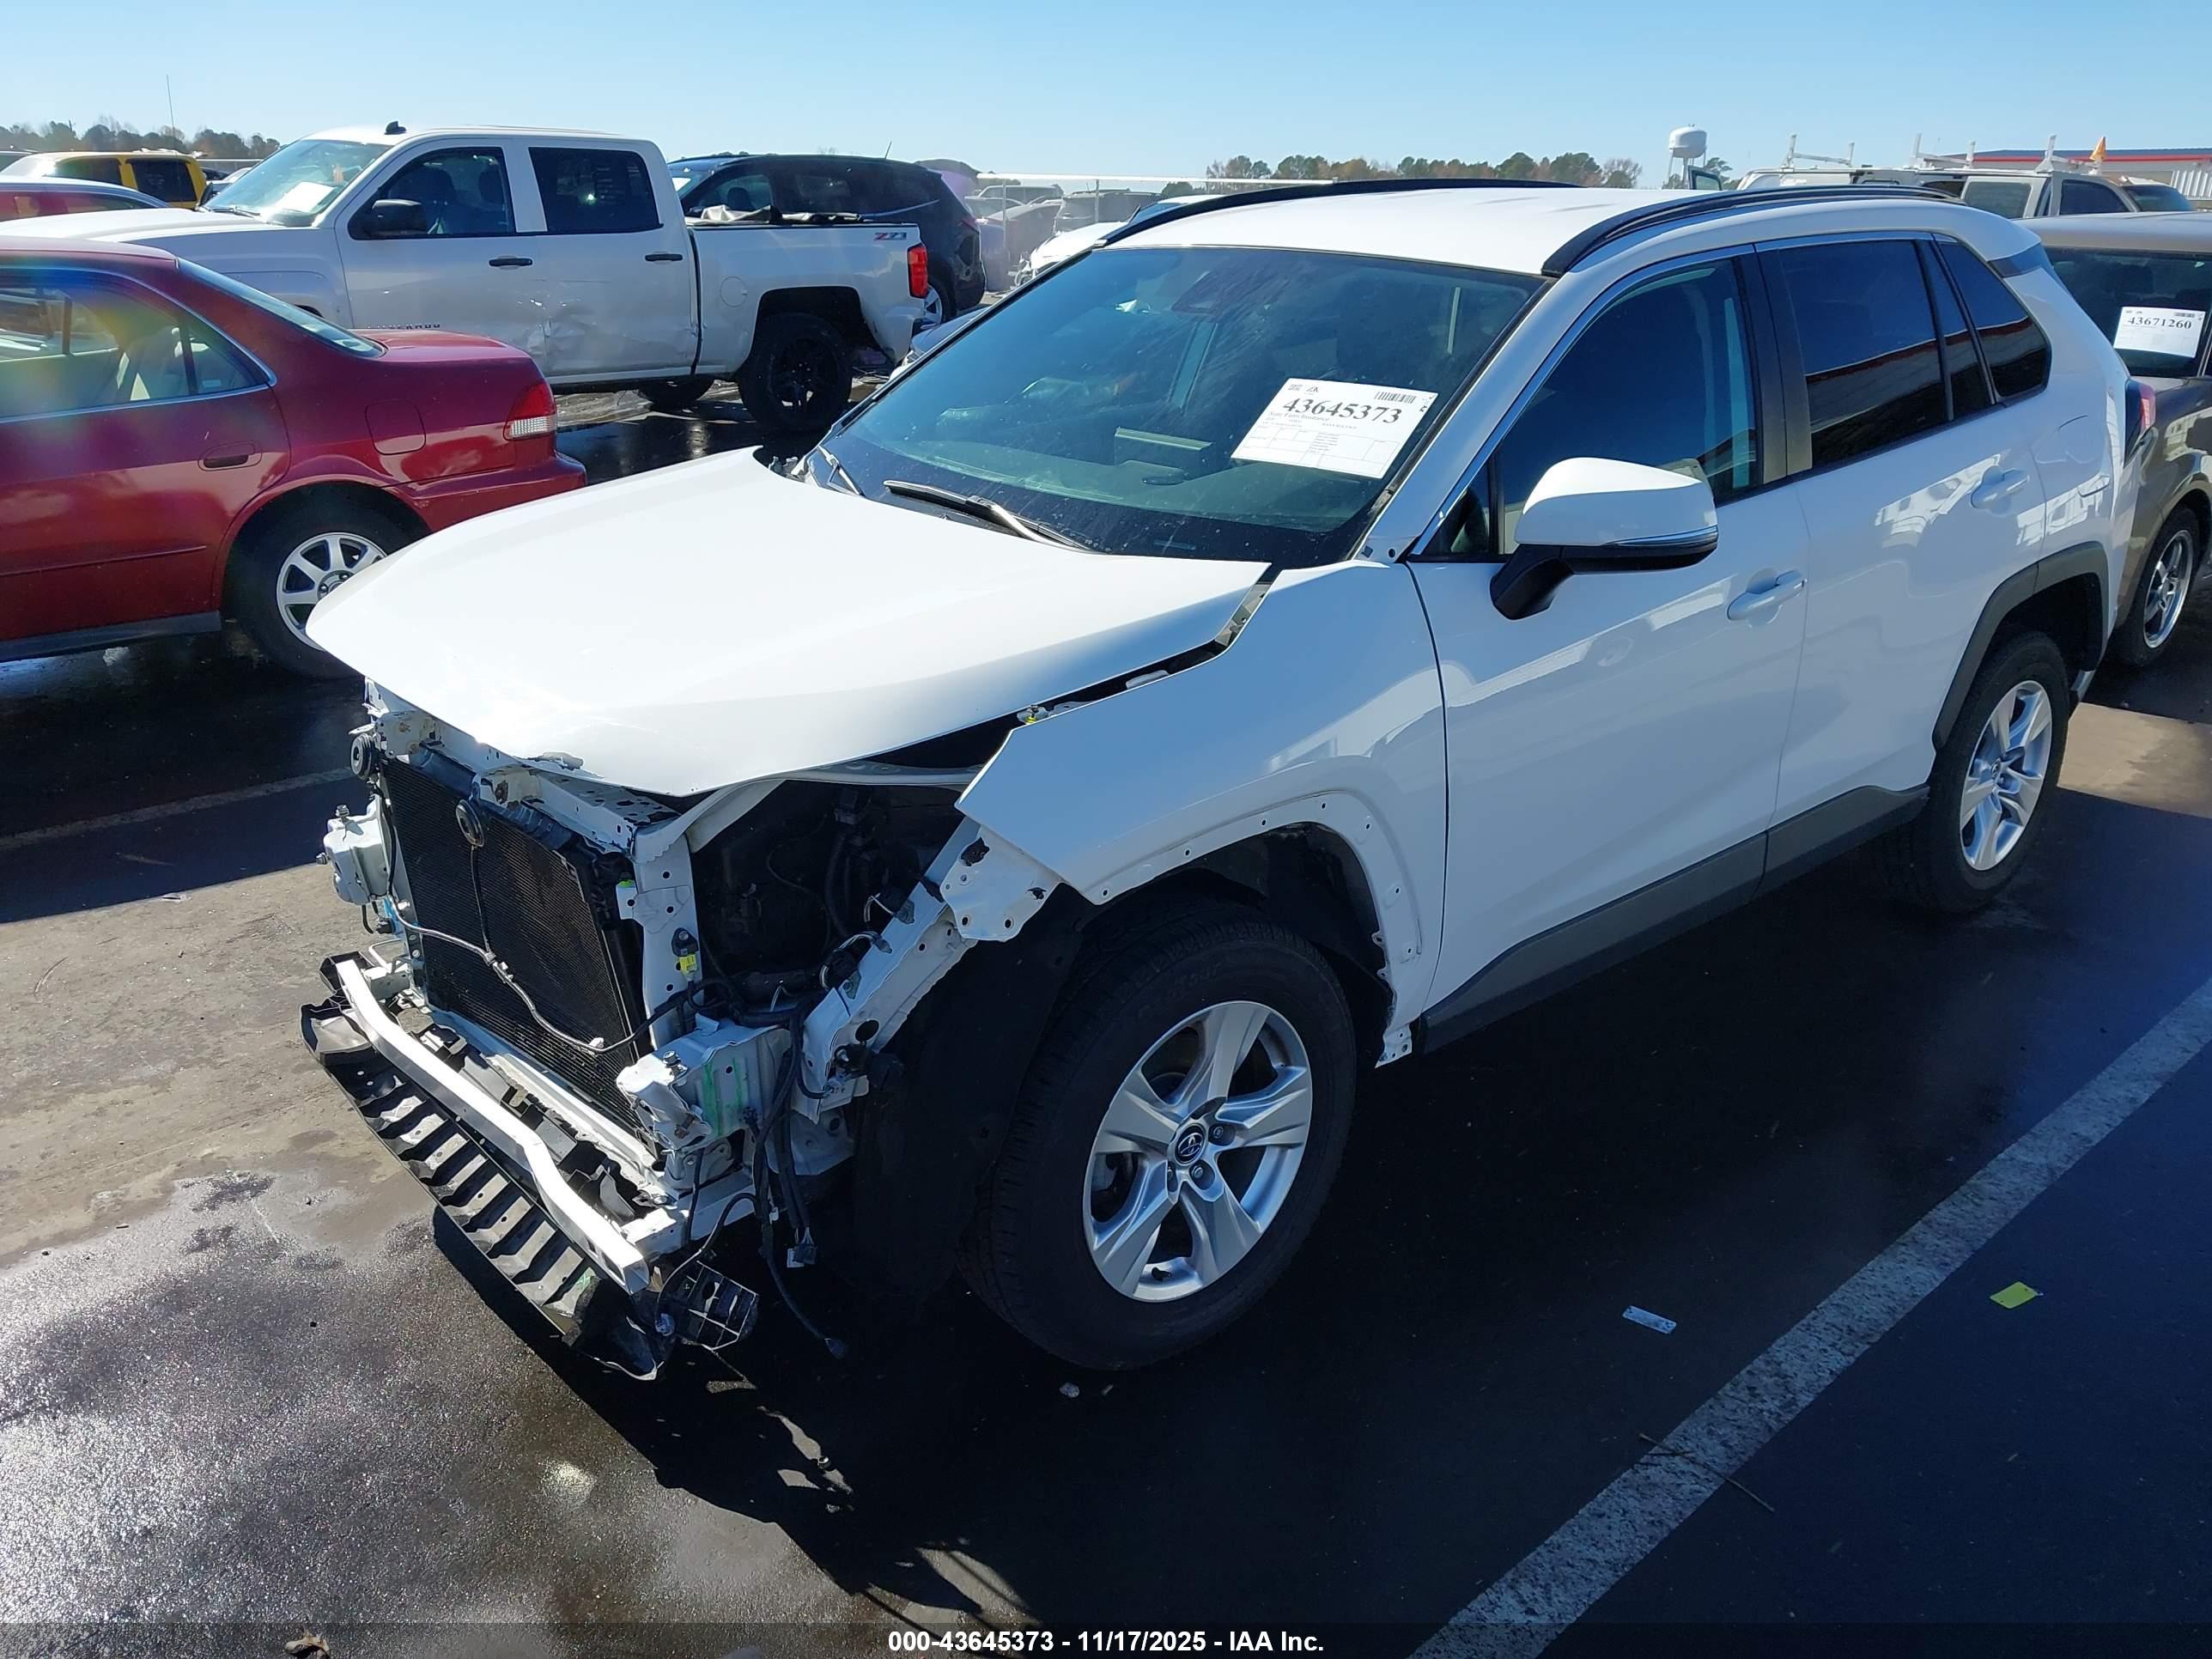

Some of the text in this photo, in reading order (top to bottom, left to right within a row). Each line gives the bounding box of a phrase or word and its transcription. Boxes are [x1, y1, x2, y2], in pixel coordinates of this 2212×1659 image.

[873, 232, 908, 240] Z71
[2128, 316, 2192, 330] 43671260
[1282, 398, 1402, 424] 43645373
